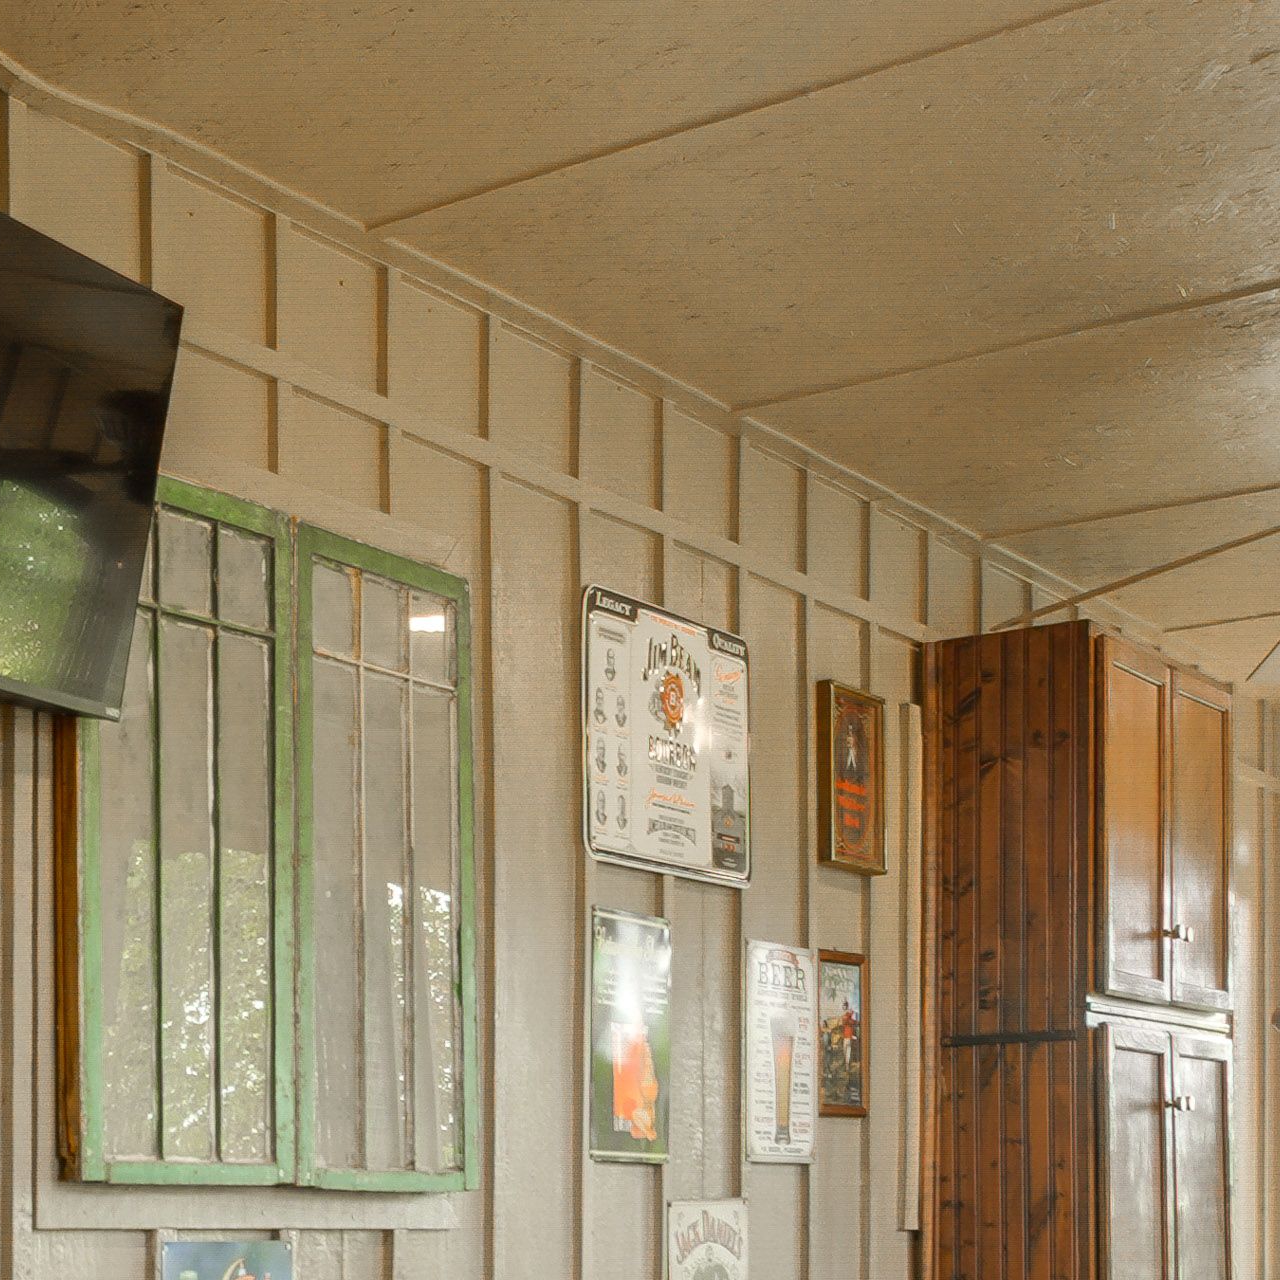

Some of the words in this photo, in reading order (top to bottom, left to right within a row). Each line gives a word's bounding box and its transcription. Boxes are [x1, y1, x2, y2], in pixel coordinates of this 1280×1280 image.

[596, 592, 632, 616] LEGACY
[641, 636, 668, 682] JIM
[669, 632, 703, 697] BEAM
[648, 734, 697, 773] BOURBON
[757, 961, 807, 993] BEER
[676, 1219, 701, 1265] JACK
